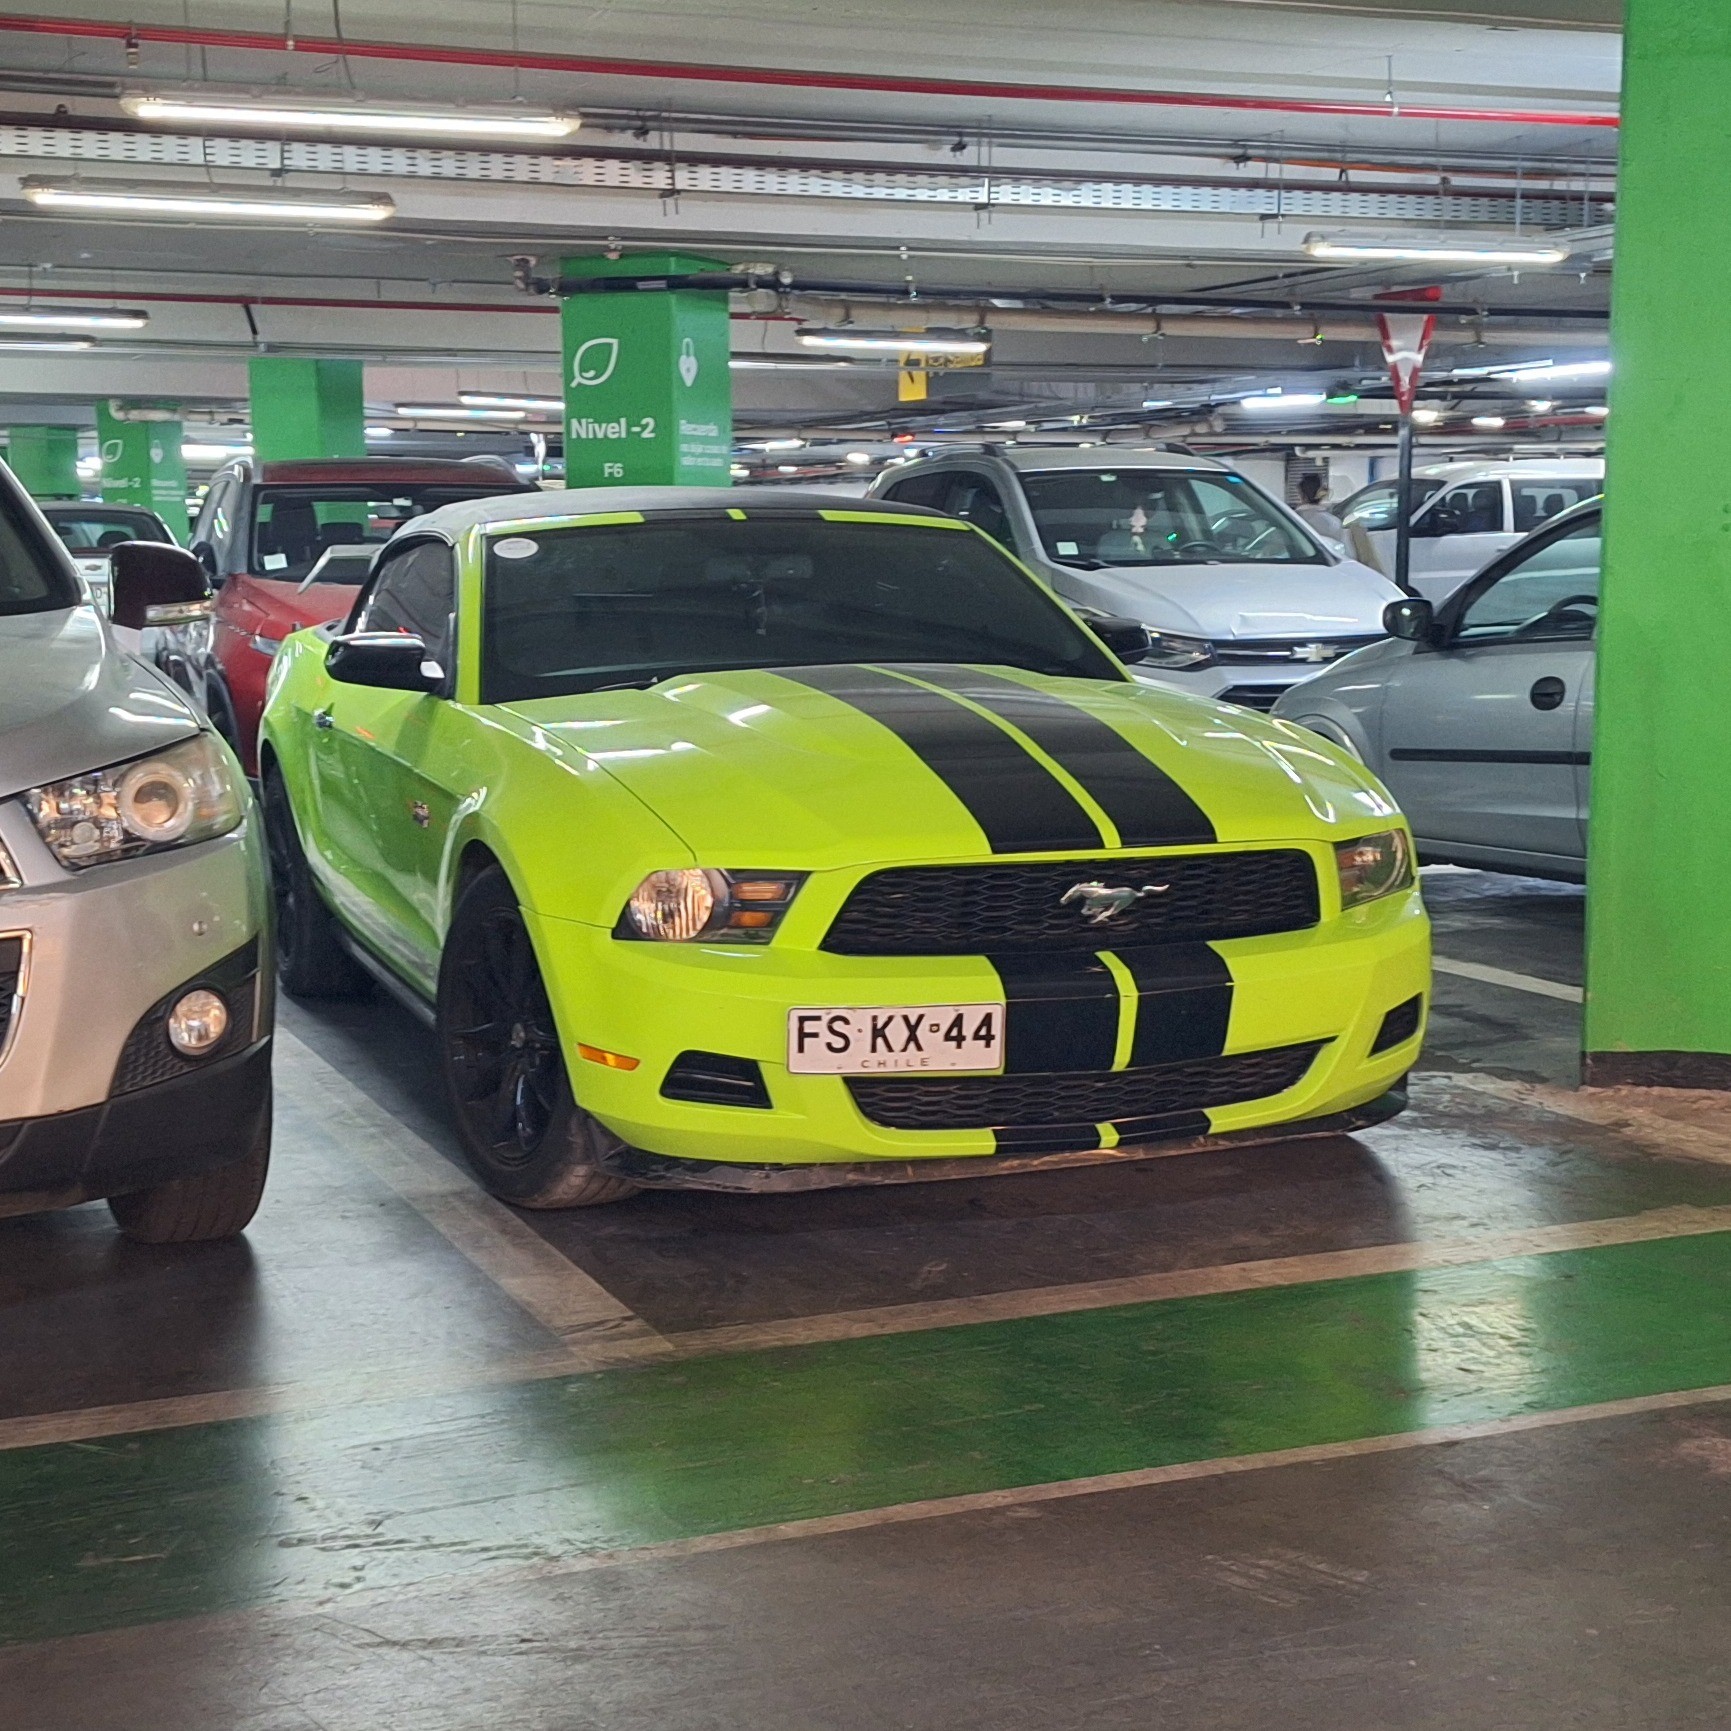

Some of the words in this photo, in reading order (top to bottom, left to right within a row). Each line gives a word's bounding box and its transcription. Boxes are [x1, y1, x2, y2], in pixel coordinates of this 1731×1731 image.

[570, 417, 627, 439] Nivel
[630, 416, 656, 438] -2
[603, 462, 624, 478] F6
[860, 1057, 930, 1069] CHILE
